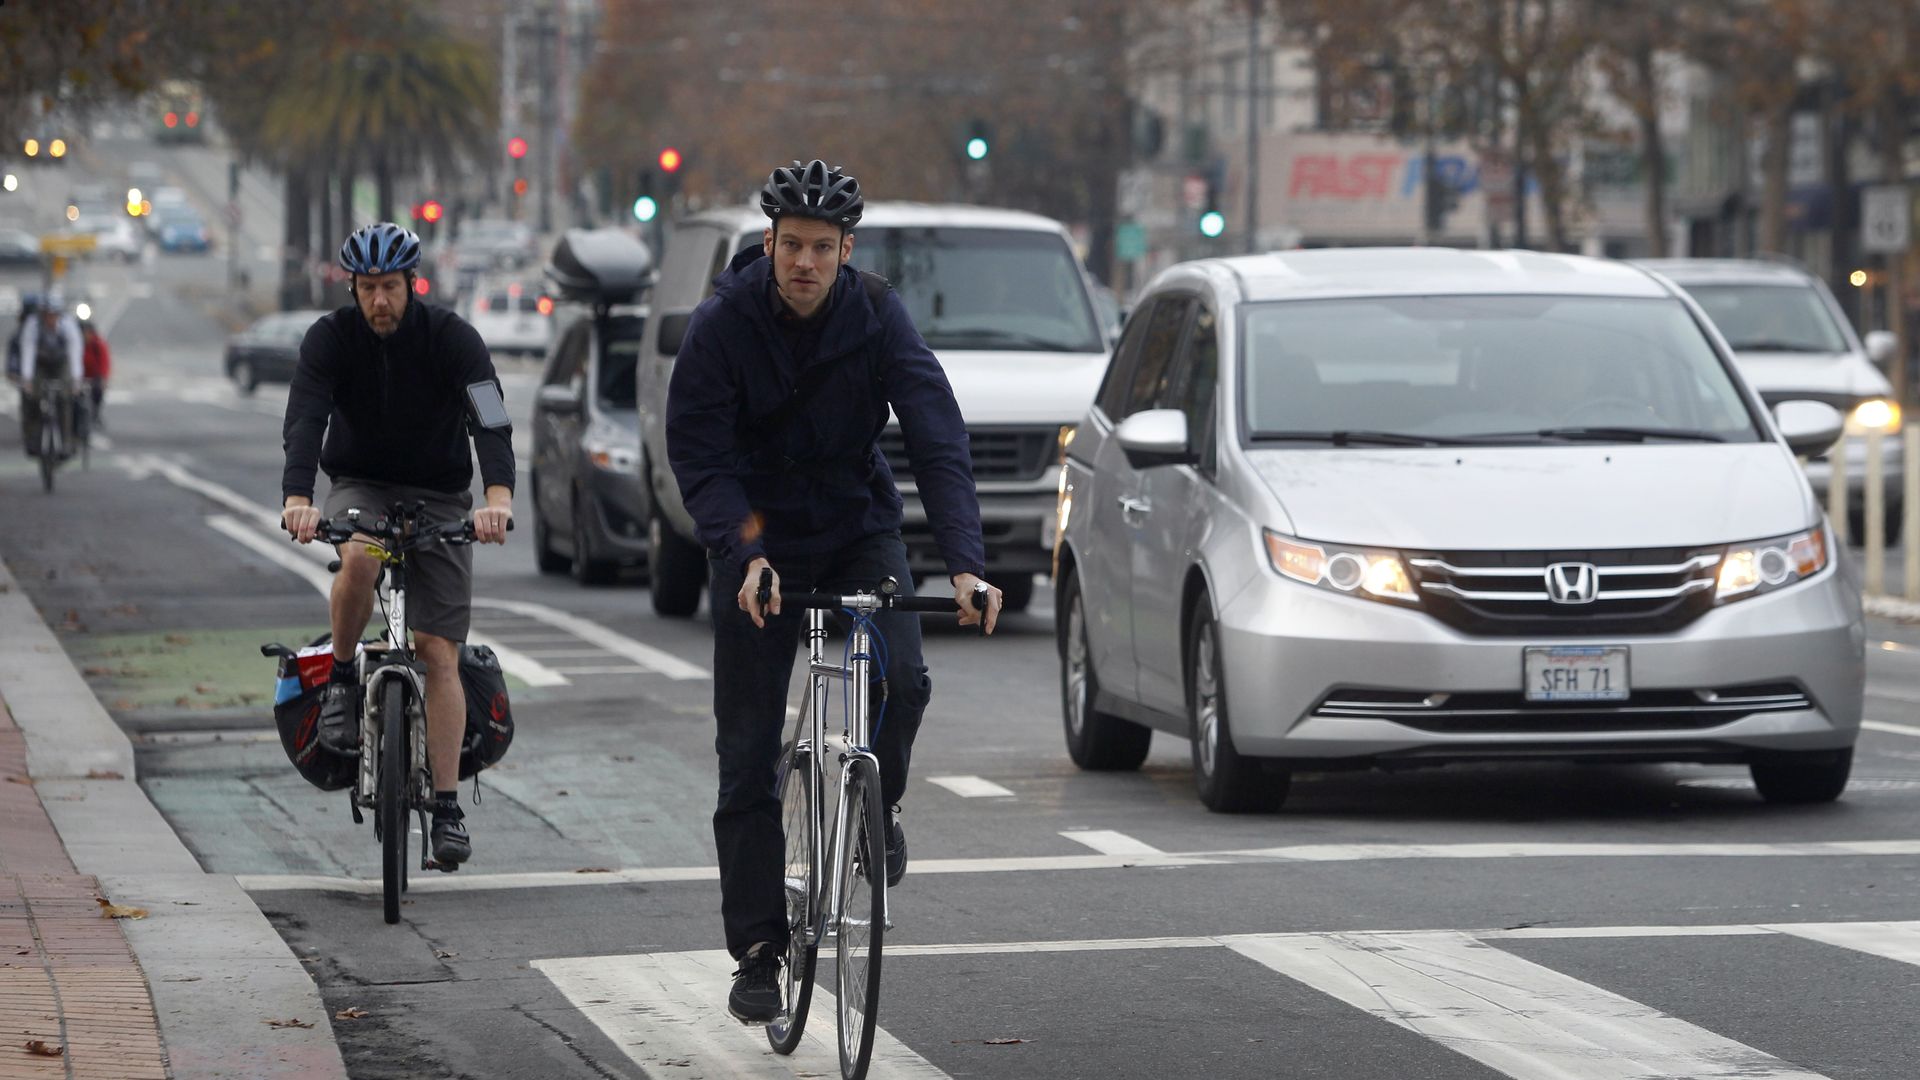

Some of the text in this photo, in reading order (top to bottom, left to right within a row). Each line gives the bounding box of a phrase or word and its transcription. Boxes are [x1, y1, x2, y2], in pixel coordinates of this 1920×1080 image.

[1288, 154, 1400, 198] FAST
[1541, 668, 1612, 691] SFH 71
